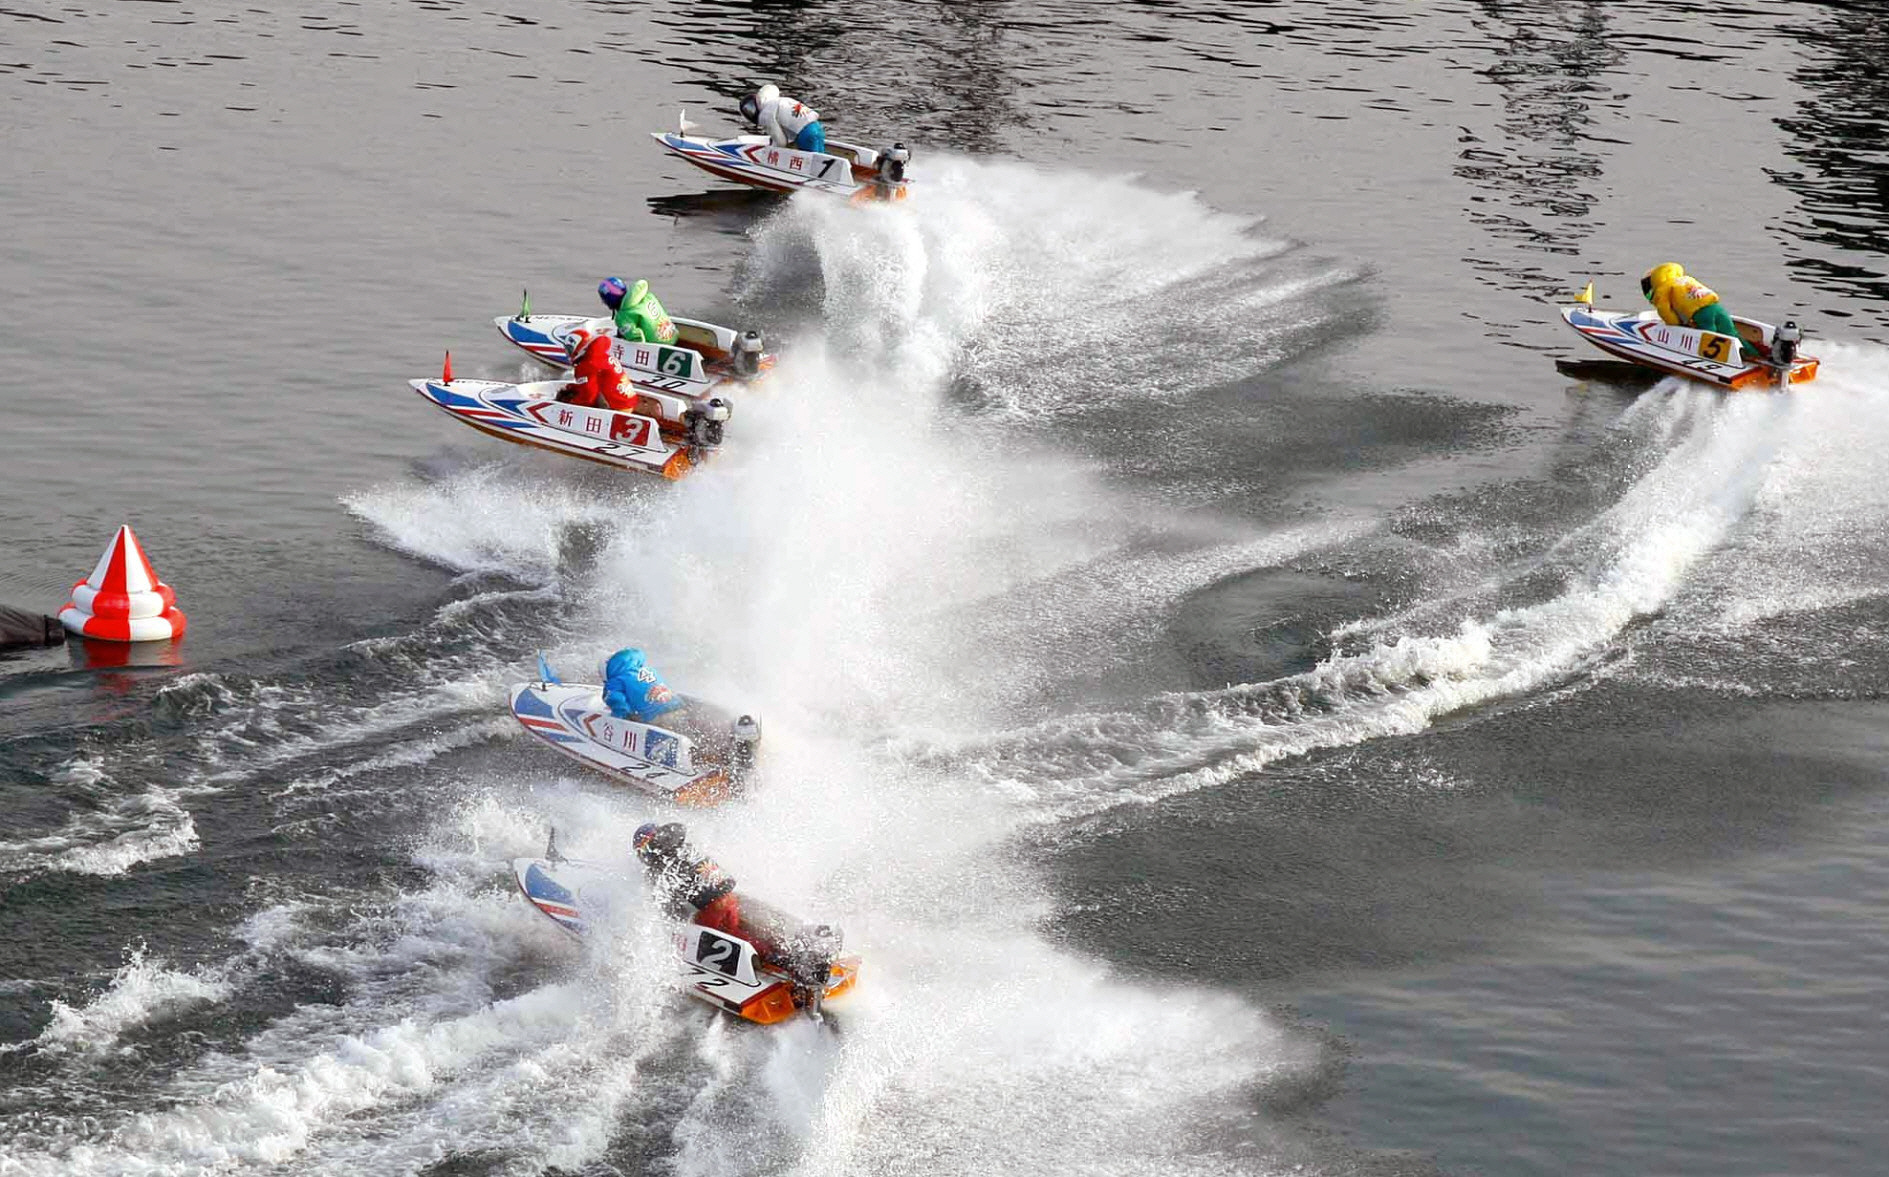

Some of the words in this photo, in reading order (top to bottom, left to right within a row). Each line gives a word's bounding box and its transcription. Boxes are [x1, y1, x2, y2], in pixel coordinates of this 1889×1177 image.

[817, 158, 836, 178] 1
[1657, 328, 1693, 351] 山川
[1702, 336, 1727, 359] 5
[662, 351, 686, 375] 6
[559, 409, 602, 433] 新田
[615, 419, 643, 442] 3
[595, 443, 646, 459] 27
[603, 722, 637, 752] 谷川
[699, 939, 733, 971] 2
